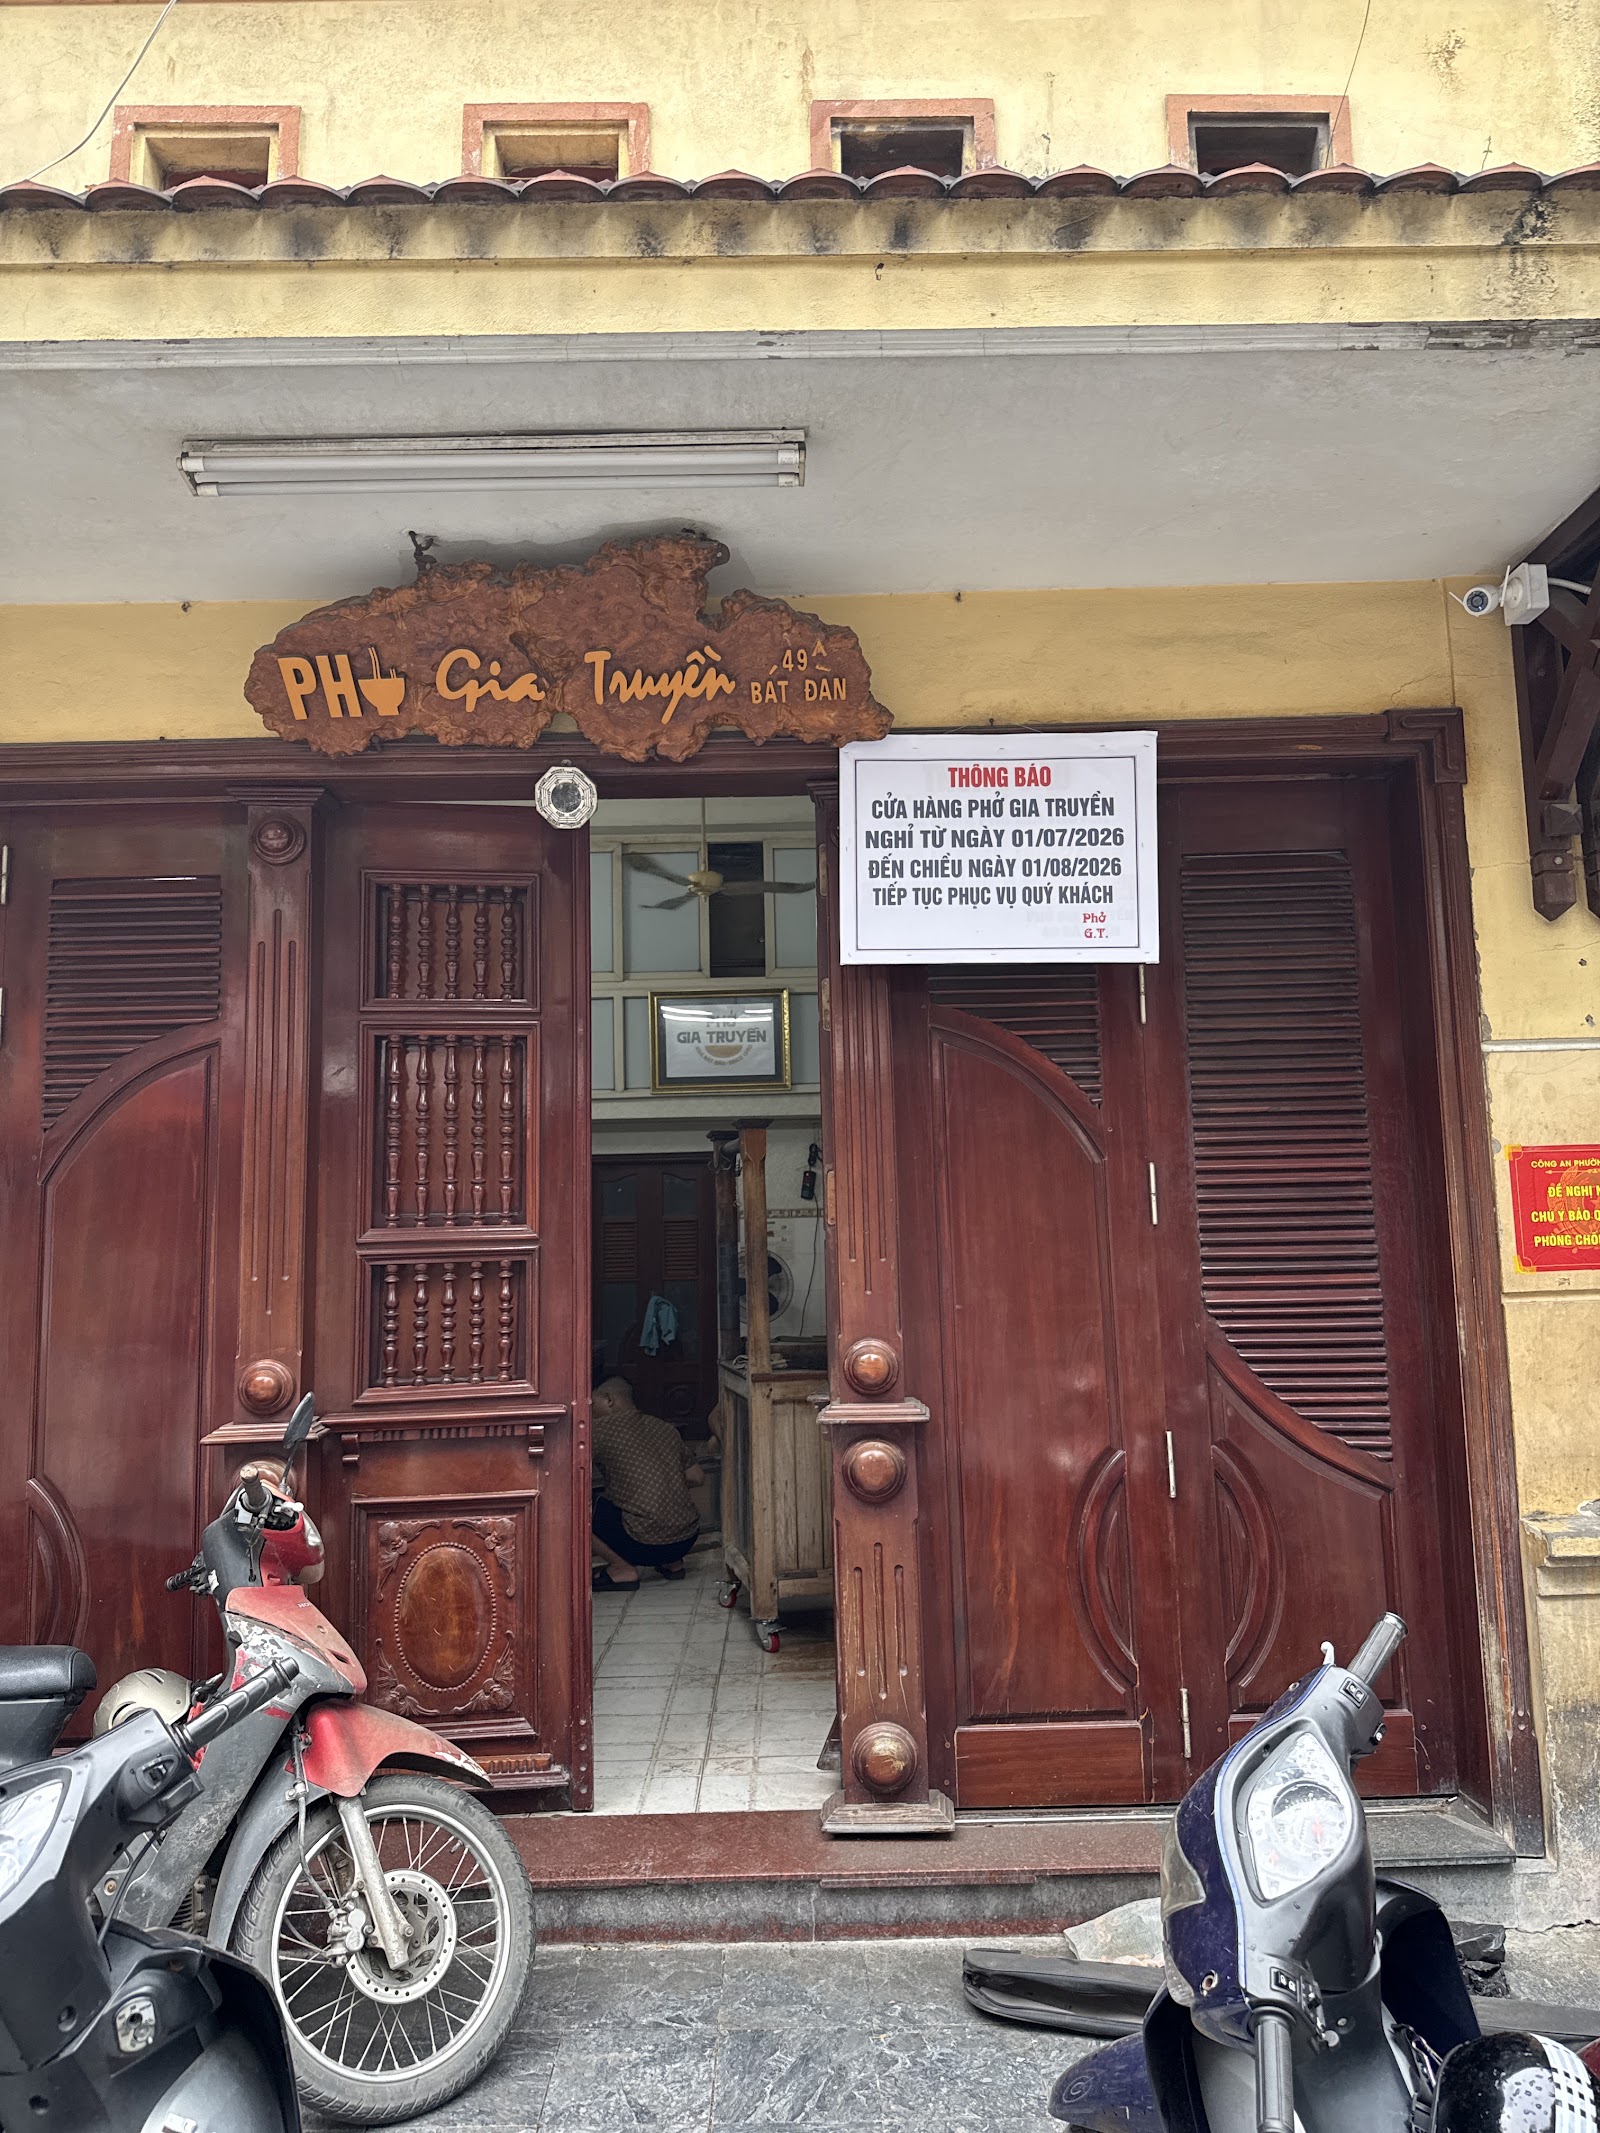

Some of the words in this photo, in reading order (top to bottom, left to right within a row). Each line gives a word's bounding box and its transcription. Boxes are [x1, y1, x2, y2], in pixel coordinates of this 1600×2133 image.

[782, 639, 827, 672] 49A
[436, 649, 546, 713] Gia
[584, 646, 736, 725] Truyền
[750, 665, 788, 704] BÁT
[804, 664, 847, 702] ĐÀN
[948, 764, 1008, 787] THÔNG
[1014, 763, 1051, 787] BÁO
[872, 792, 908, 819] CỬA
[913, 793, 962, 818] HÀNG
[968, 791, 1004, 818] PHỞ
[1010, 799, 1040, 817] GIA
[1045, 791, 1115, 816] TRUYỀN
[865, 823, 913, 848] NGHỈ
[920, 826, 947, 848] TỪ
[951, 826, 1005, 847] NGÀY
[1011, 828, 1124, 847] 01/07/2026
[868, 853, 904, 878] ĐẾN
[910, 853, 962, 878] CHIỀU
[969, 855, 1016, 877] NGÀY
[1022, 858, 1122, 877] 01/08/2026
[873, 882, 907, 906] TIẾP
[913, 887, 942, 909] TỤC
[948, 887, 991, 909] PHỤC
[996, 886, 1017, 908] VỤ
[1022, 882, 1053, 906] QUÝ
[1059, 882, 1113, 903] KHÁCH
[1083, 912, 1106, 923] Phở
[1084, 928, 1109, 938] G.T.
[676, 1031, 701, 1043] GIA
[1531, 1159, 1557, 1168] CÔNG
[1559, 1160, 1571, 1168] AN
[1566, 1185, 1593, 1198] NGHỊ
[1568, 1207, 1590, 1221] BẢO
[1534, 1233, 1572, 1247] PHÒNG
[1575, 1230, 1600, 1245] CHỐ
